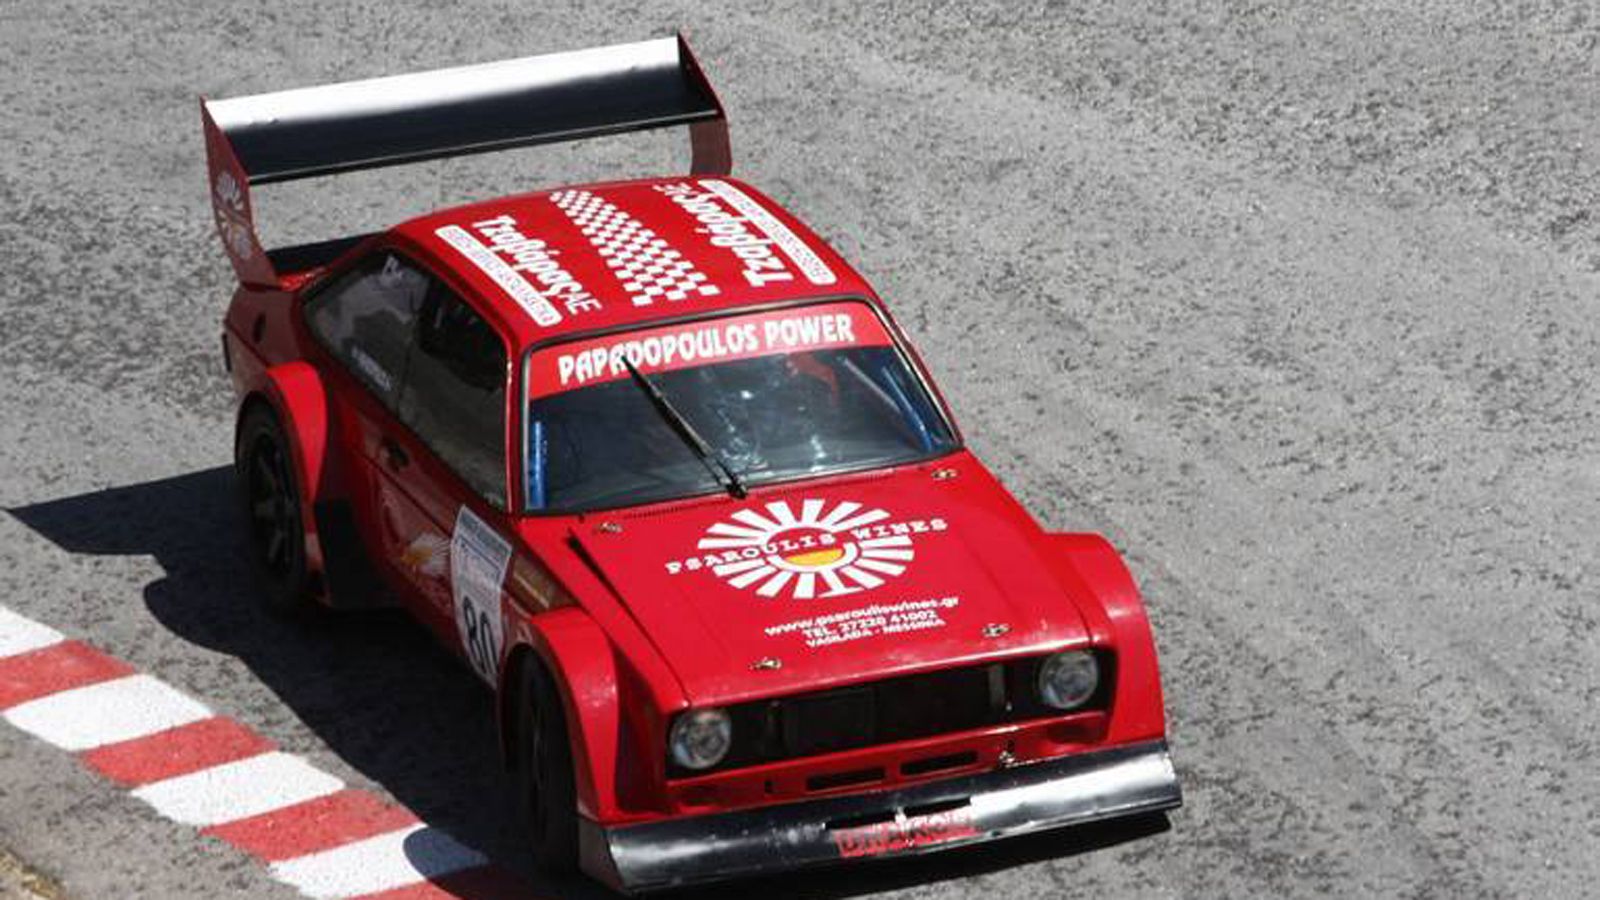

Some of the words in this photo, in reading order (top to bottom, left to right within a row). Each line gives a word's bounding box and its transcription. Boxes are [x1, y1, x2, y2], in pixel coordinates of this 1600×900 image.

[557, 324, 759, 386] PAPADOPOULOS
[764, 313, 855, 351] POWER
[665, 532, 837, 575] PSAROULIS
[851, 518, 948, 542] WINES
[463, 596, 499, 676] 80
